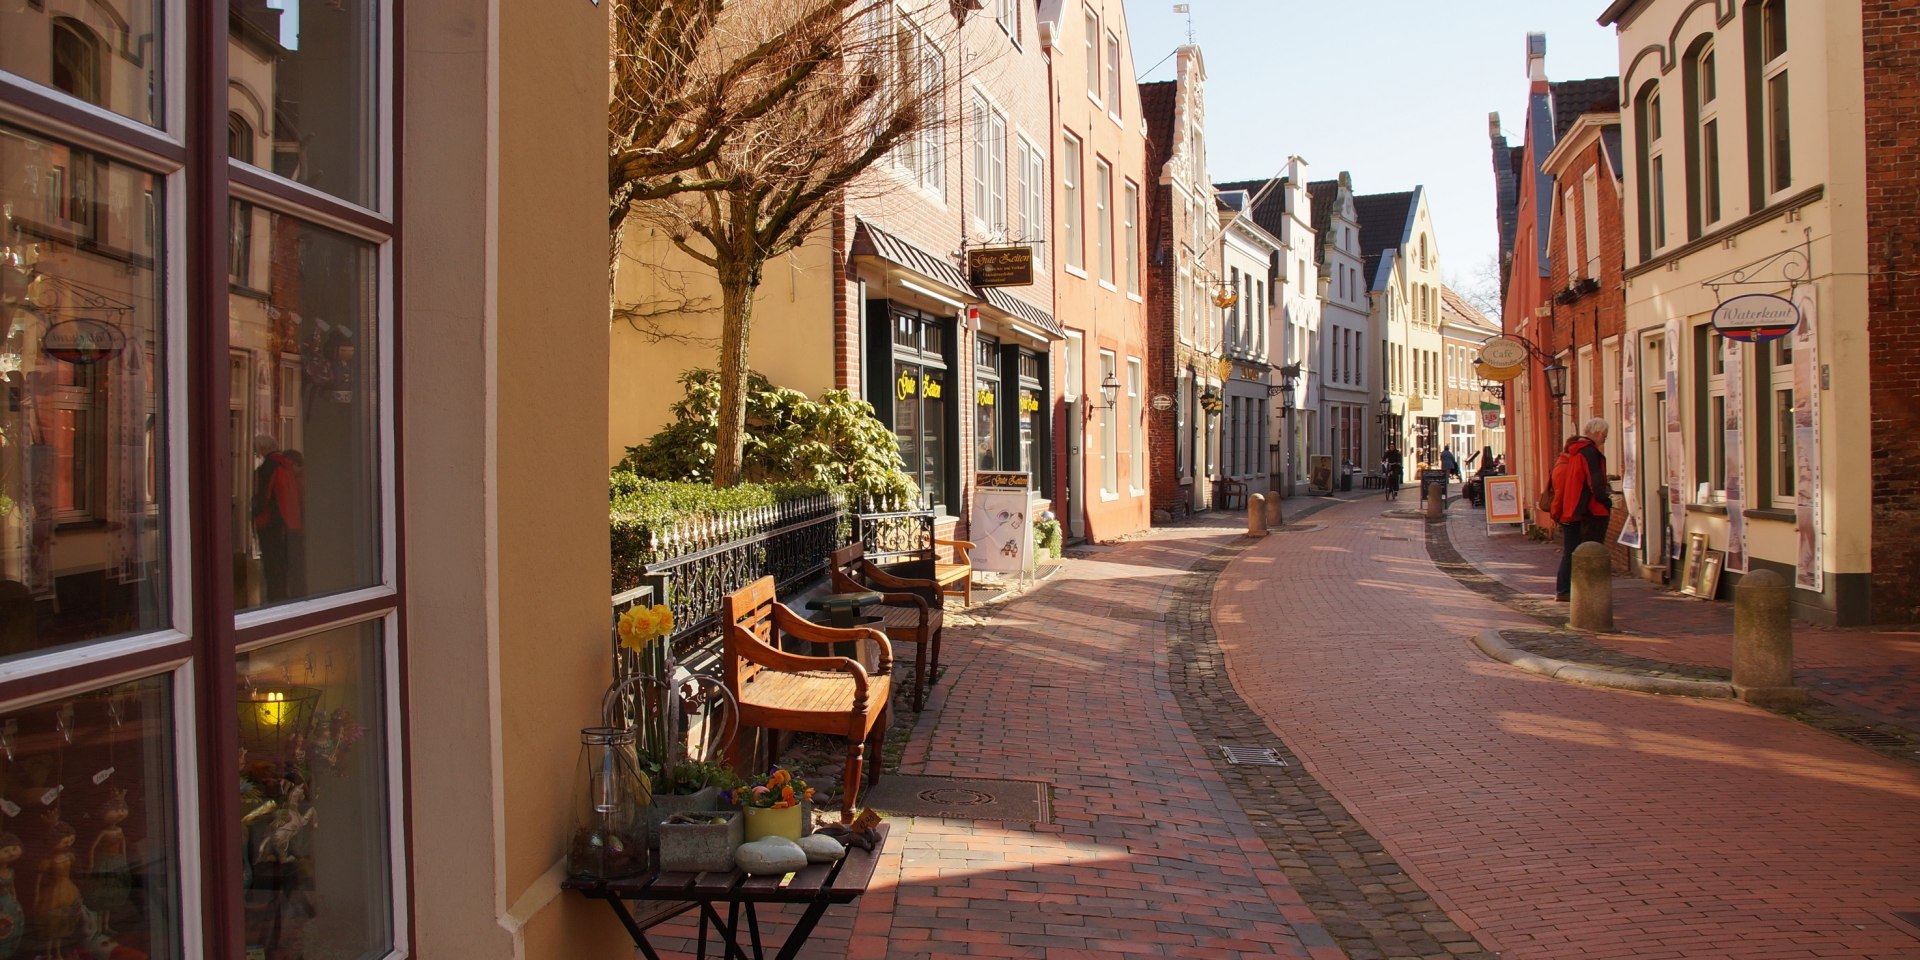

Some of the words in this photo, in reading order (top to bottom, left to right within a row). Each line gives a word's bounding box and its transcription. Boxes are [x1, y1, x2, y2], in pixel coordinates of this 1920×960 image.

[971, 254, 997, 268] Gute
[999, 252, 1030, 264] Zeiten
[1721, 307, 1792, 320] Waterkant
[1492, 349, 1514, 358] Café
[898, 370, 915, 400] Gute
[922, 373, 941, 398] Zeiten
[1485, 413, 1497, 421] EIS
[992, 474, 1008, 487] Gute
[1008, 474, 1028, 486] Zeiten
